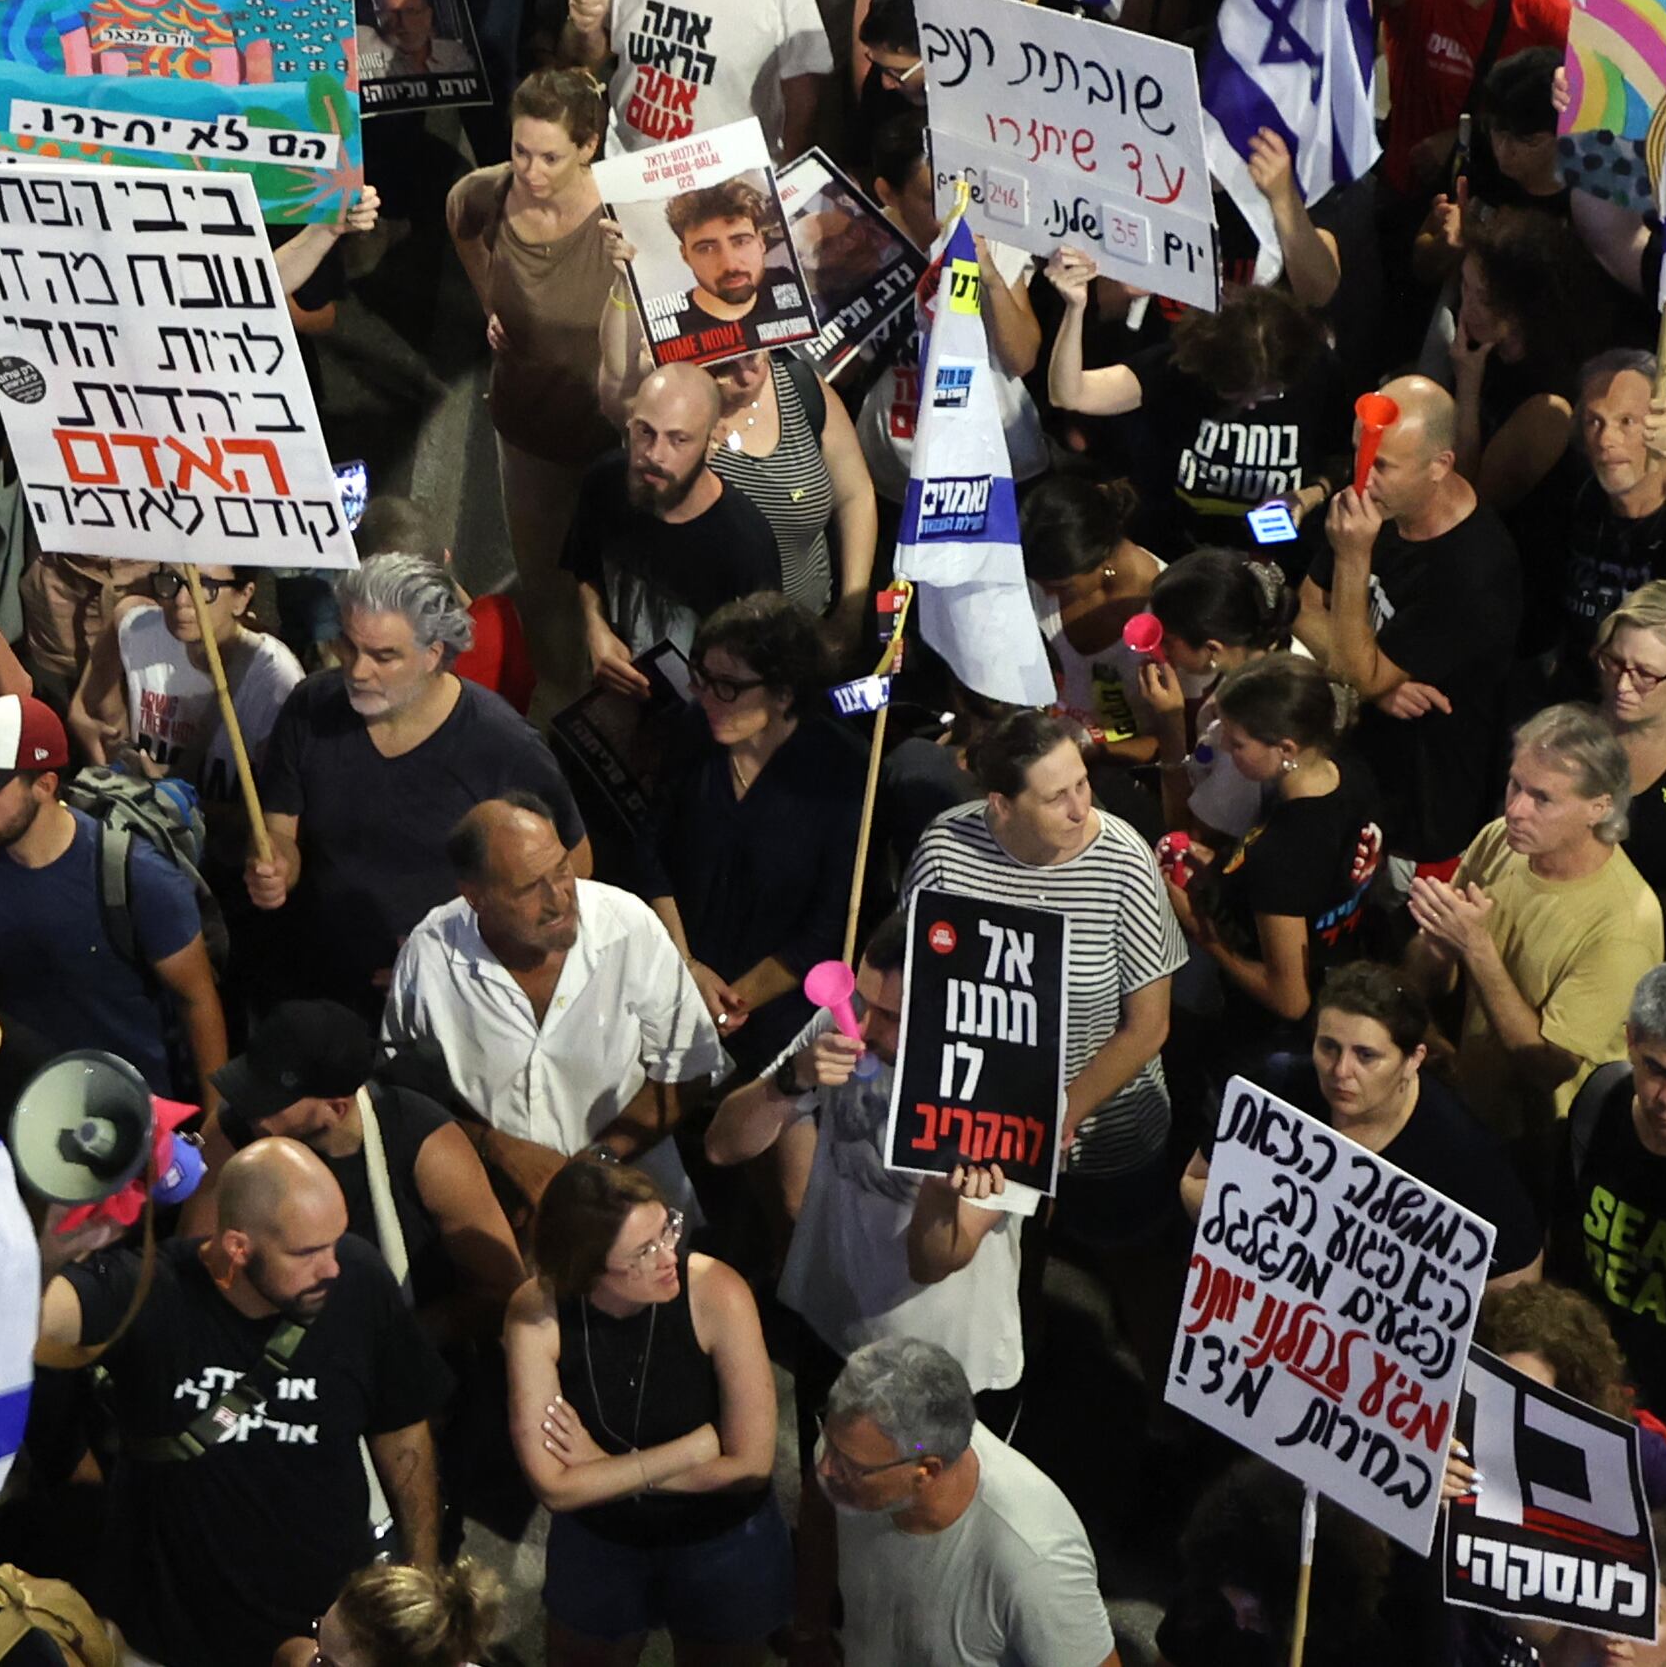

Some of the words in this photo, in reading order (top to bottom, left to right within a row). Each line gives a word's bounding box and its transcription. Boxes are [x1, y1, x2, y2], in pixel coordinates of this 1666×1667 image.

[641, 0, 713, 50] אתה
[628, 31, 718, 86] הראש
[921, 22, 995, 88] רעב
[362, 82, 427, 105] סליחה!
[436, 77, 477, 98] יורם,
[633, 63, 700, 116] אתה
[1006, 41, 1175, 136] שובתת
[22, 106, 171, 147] יחזרו.
[185, 117, 249, 154] לא
[267, 133, 328, 162] הם
[623, 94, 695, 143] אשם
[985, 112, 1097, 172] שיחזרו
[642, 168, 662, 185] GUY
[661, 154, 722, 181] GILBOA-DALAL
[987, 183, 1020, 211] 246
[1120, 141, 1185, 205] עד
[114, 181, 256, 238] ביבי
[1110, 217, 1138, 249] 35
[37, 249, 119, 306] מה
[1163, 230, 1205, 273] יום
[126, 252, 278, 311] שכח
[643, 290, 690, 320] BRING
[1, 315, 120, 368] יהודי
[157, 321, 285, 376] להיות
[650, 318, 682, 342] HIM
[658, 333, 700, 363] HOME
[699, 324, 747, 352] NOW!
[56, 381, 306, 433] ביהדות
[50, 428, 292, 498] האדם
[1194, 417, 1299, 466] בוחרים
[26, 481, 206, 536] לאדמה
[214, 495, 341, 555] קודם
[977, 918, 1035, 987] אל
[945, 976, 1038, 1047] תתנו
[939, 1040, 984, 1102] לו
[911, 1103, 1046, 1167] להקריב
[1214, 1092, 1338, 1183] הזאת
[1262, 1173, 1317, 1238] רב
[1349, 1156, 1493, 1272] הממשלה
[1201, 1181, 1333, 1301] מתגלגל
[1332, 1202, 1406, 1290] פיגוע
[1183, 1253, 1257, 1335] יותר
[1403, 1264, 1473, 1329] היא
[1238, 1294, 1371, 1402] לכולנו
[1338, 1286, 1456, 1380] נפגעים
[1361, 1347, 1452, 1455] מגיע
[1274, 1397, 1434, 1511] בחירות
[1462, 1358, 1641, 1538] כן
[1454, 1533, 1648, 1618] לעסקה!
